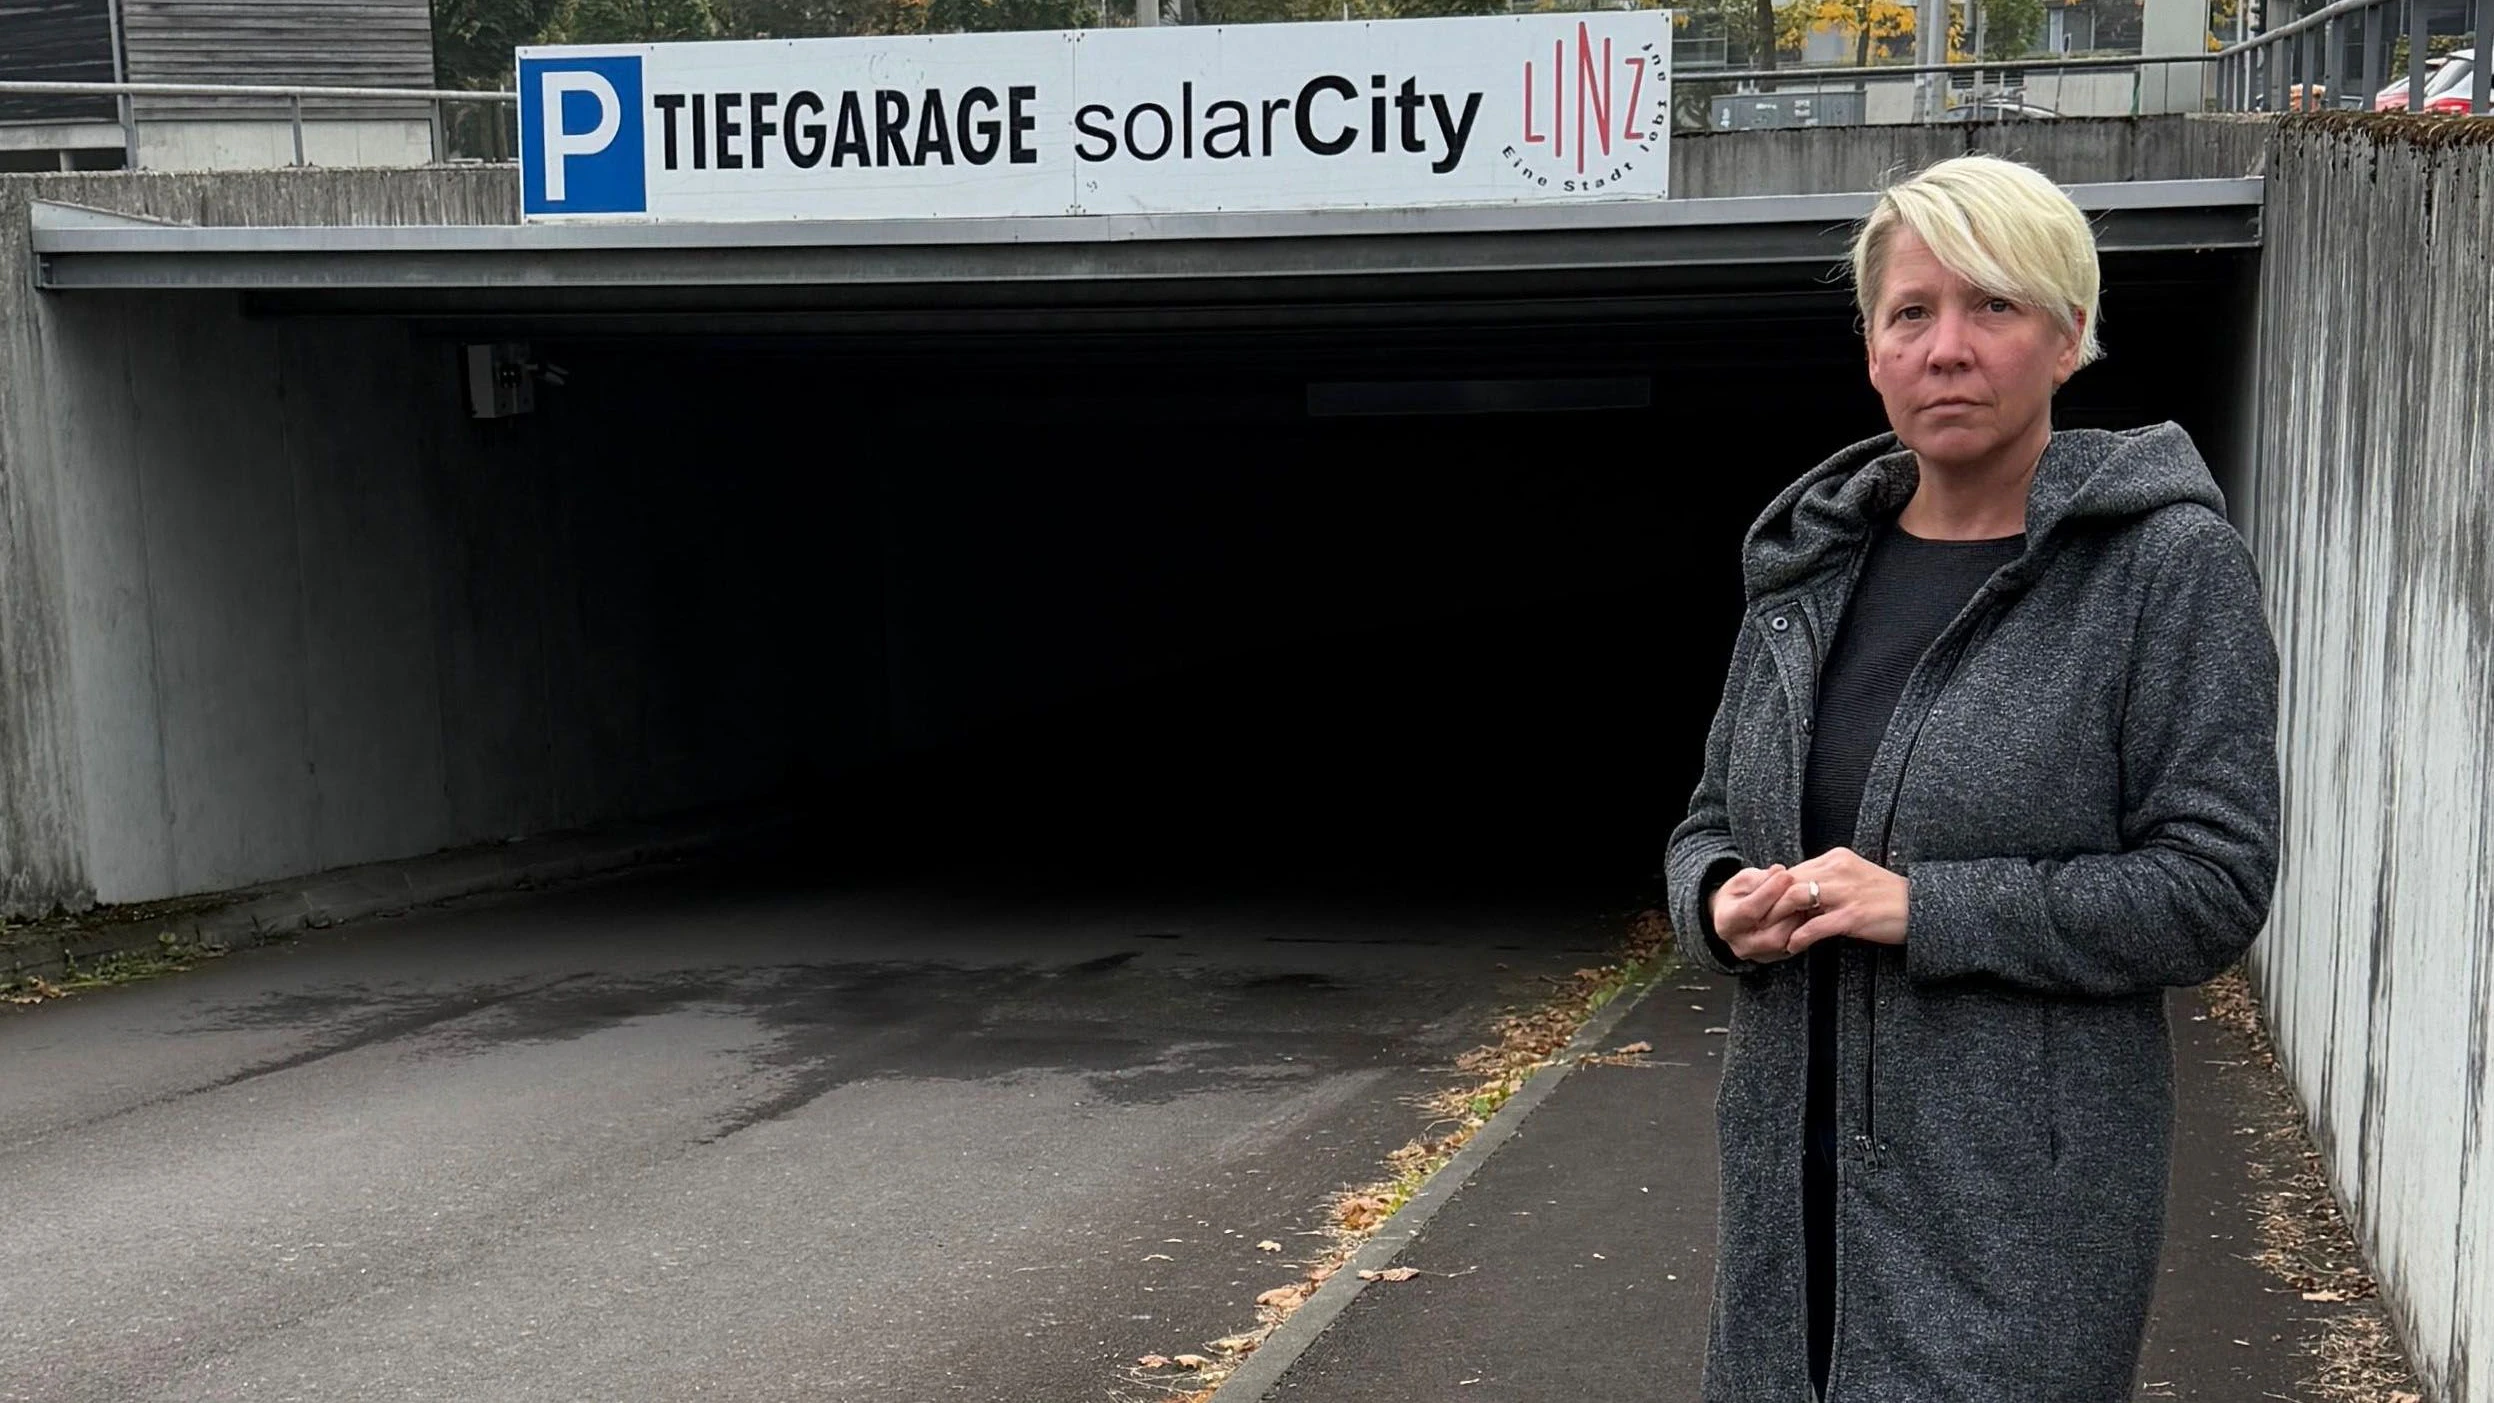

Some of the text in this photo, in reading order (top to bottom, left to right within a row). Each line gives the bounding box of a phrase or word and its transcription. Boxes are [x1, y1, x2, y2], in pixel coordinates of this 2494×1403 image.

[541, 71, 621, 201] P
[653, 73, 1485, 175] TIEFGARAGE solarCity
[1524, 20, 1646, 175] LINZ
[1502, 145, 1548, 187] Eine
[1563, 161, 1633, 192] Stadt
